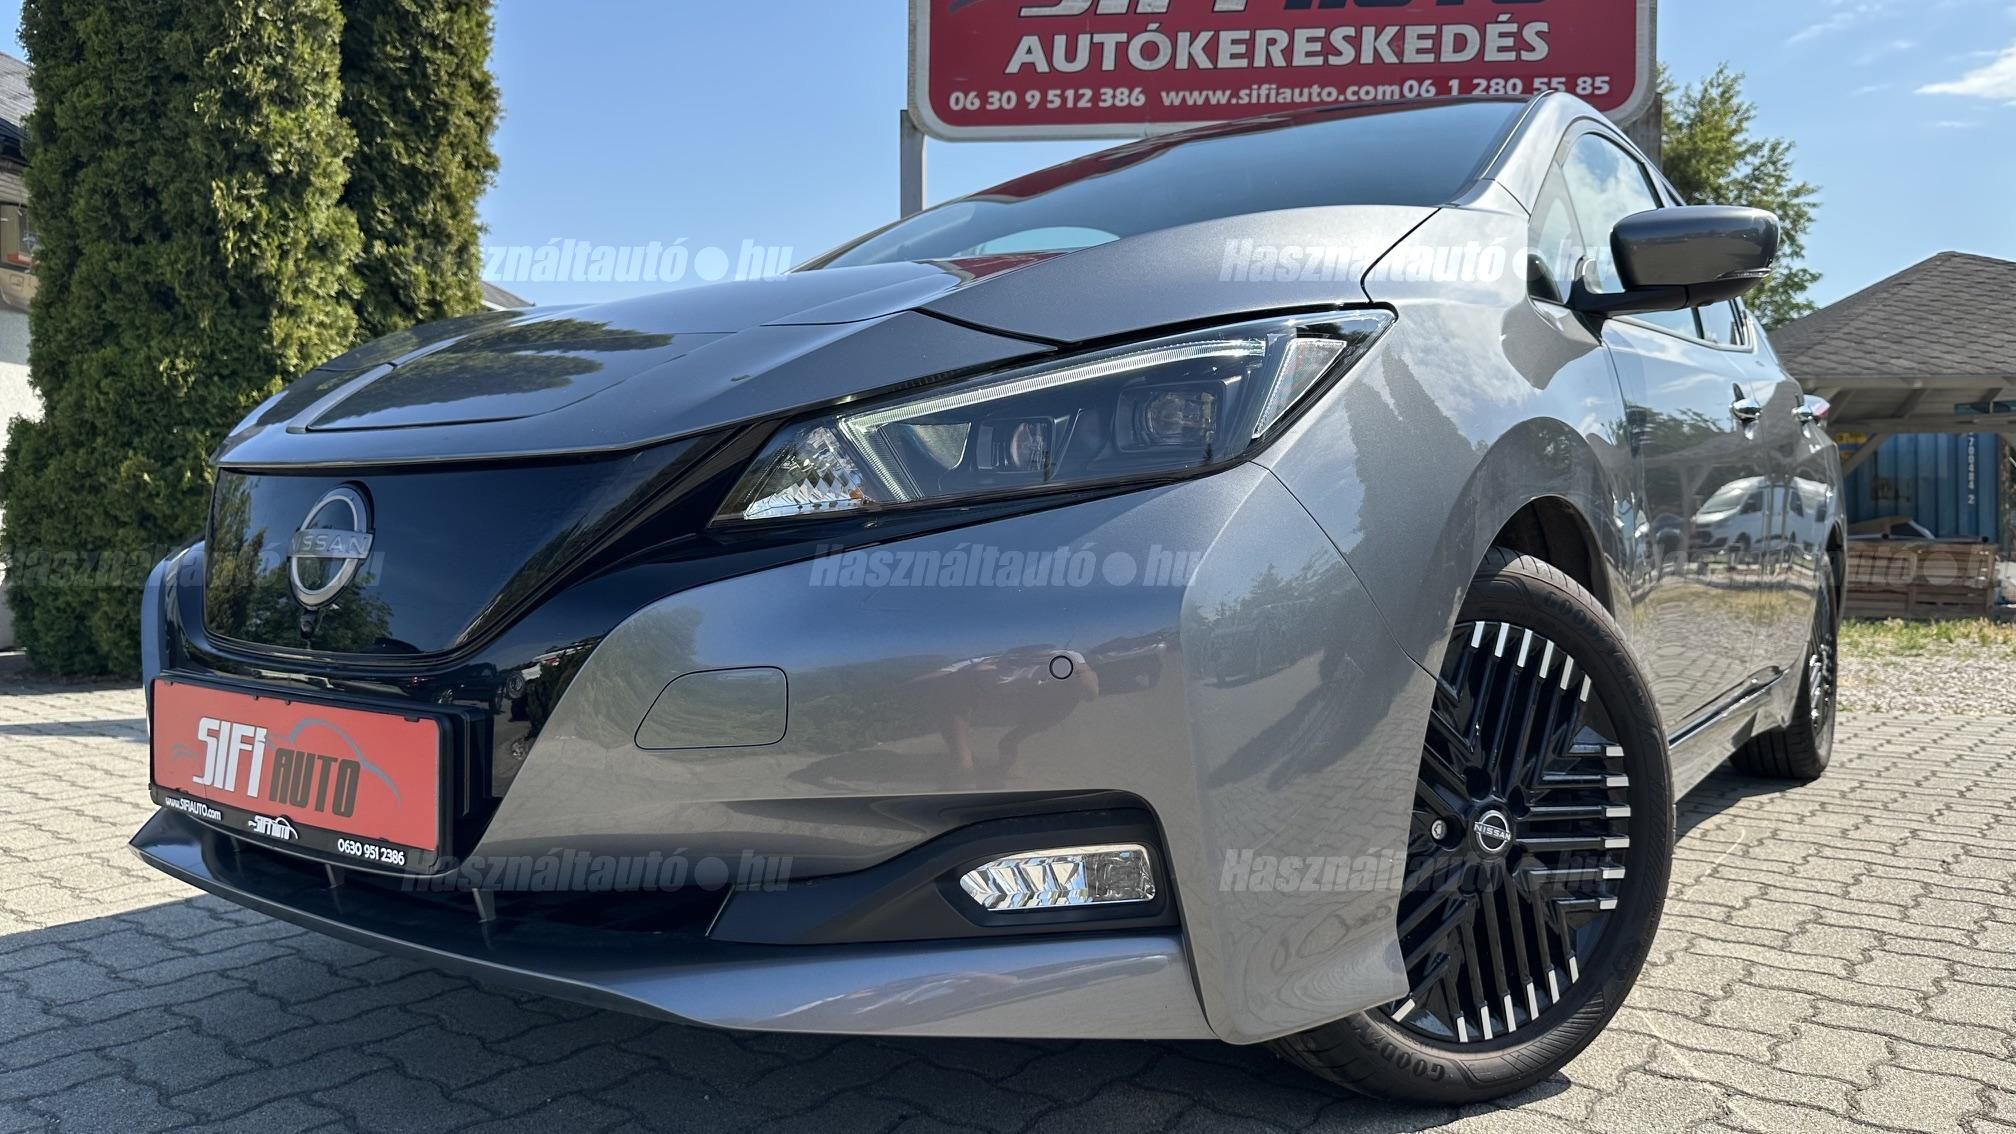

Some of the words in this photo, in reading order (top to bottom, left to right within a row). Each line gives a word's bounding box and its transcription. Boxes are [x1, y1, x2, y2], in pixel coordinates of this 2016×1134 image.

[1004, 14, 1549, 74] AUTÓKERESKEDÉS
[949, 91, 980, 111] 06
[985, 90, 1018, 110] 30
[1025, 89, 1041, 109] 9
[1046, 88, 1092, 109] 512
[1098, 87, 1146, 107] 386
[1161, 83, 1399, 106] www.sifiauto.com
[1403, 79, 1436, 98] 06
[1449, 79, 1458, 97] 1
[1472, 78, 1522, 96] 280
[1533, 77, 1566, 94] 55
[1575, 76, 1610, 95] 85
[269, 747, 361, 818] AUTO
[1473, 822, 1511, 842] NISSAN
[337, 838, 363, 856] 0630
[364, 844, 379, 860] 951
[380, 847, 405, 866] 2386
